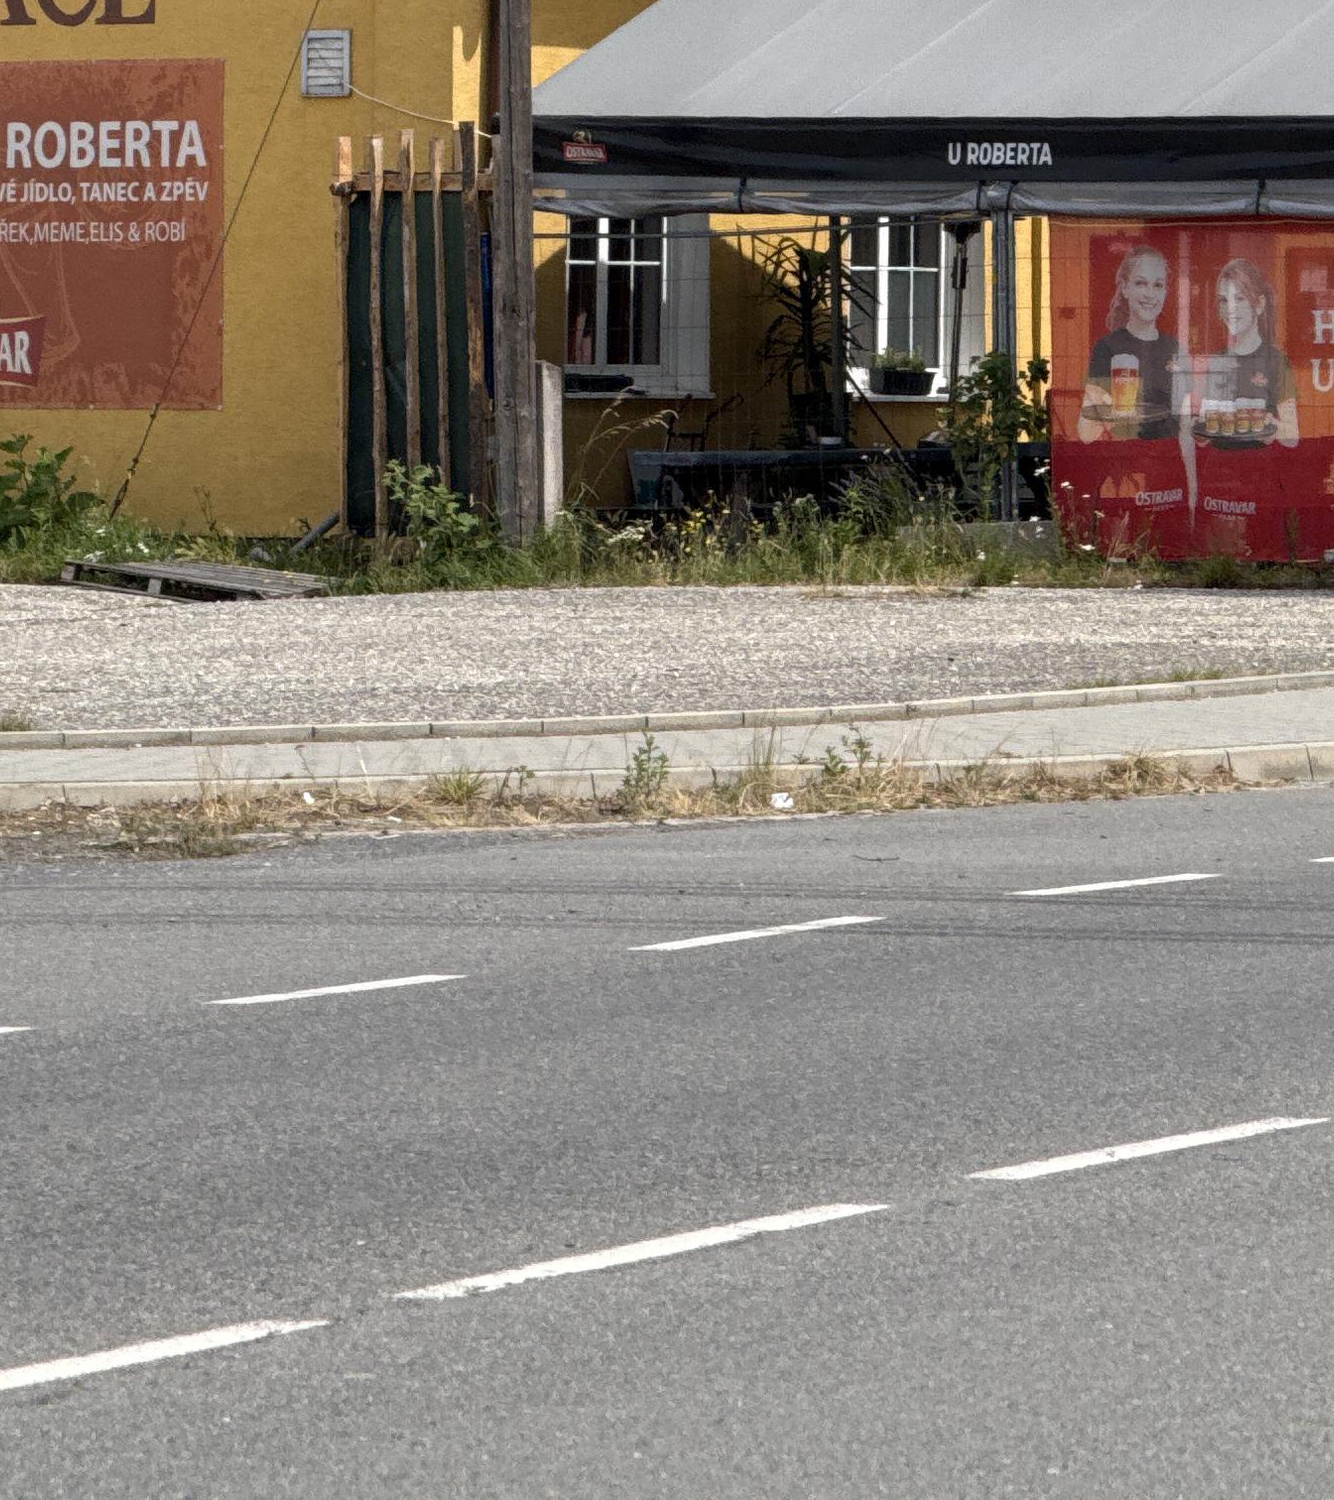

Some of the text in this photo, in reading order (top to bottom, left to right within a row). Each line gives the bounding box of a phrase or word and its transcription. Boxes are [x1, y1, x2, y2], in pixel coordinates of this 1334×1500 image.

[6, 120, 208, 169] ROBERTA
[948, 142, 1053, 165] U ROBERTA
[20, 178, 76, 205] JÍDLO,
[80, 181, 140, 202] TANEC
[143, 182, 157, 202] A
[161, 177, 209, 202] ZPĚV
[128, 221, 141, 242] &
